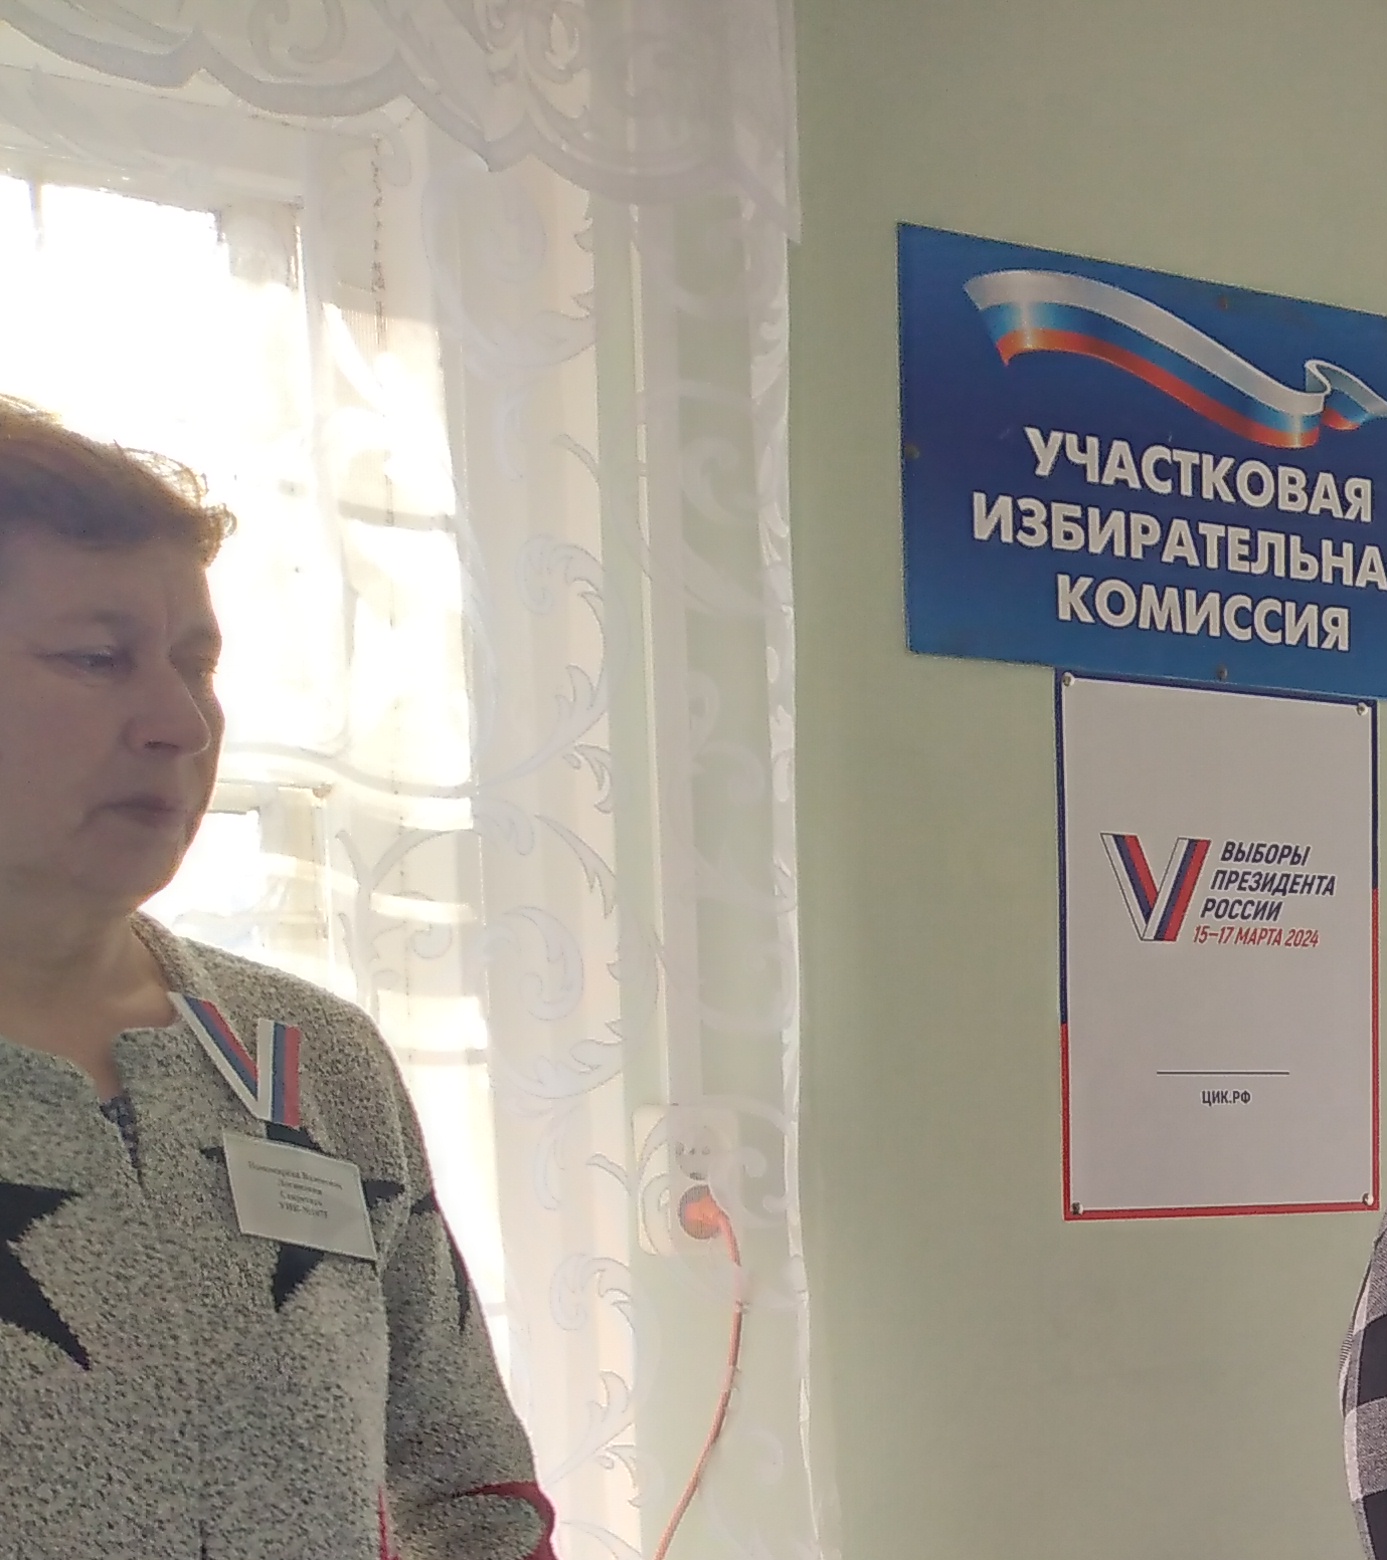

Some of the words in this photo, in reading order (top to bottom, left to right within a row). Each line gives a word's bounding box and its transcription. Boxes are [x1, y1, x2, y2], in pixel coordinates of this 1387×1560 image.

[1024, 426, 1372, 522] УЧАСТКОВАЯ
[1056, 574, 1350, 650] КОМИССИЯ
[1221, 841, 1311, 866] ВЫБОРЫ
[1210, 869, 1336, 896] ПРЕЗИДЕНТА
[1200, 898, 1283, 921] РОССИИ
[1234, 927, 1283, 946] МАРТА
[1284, 929, 1320, 948] 2024
[1201, 1089, 1251, 1106] ЦИК.РФ
